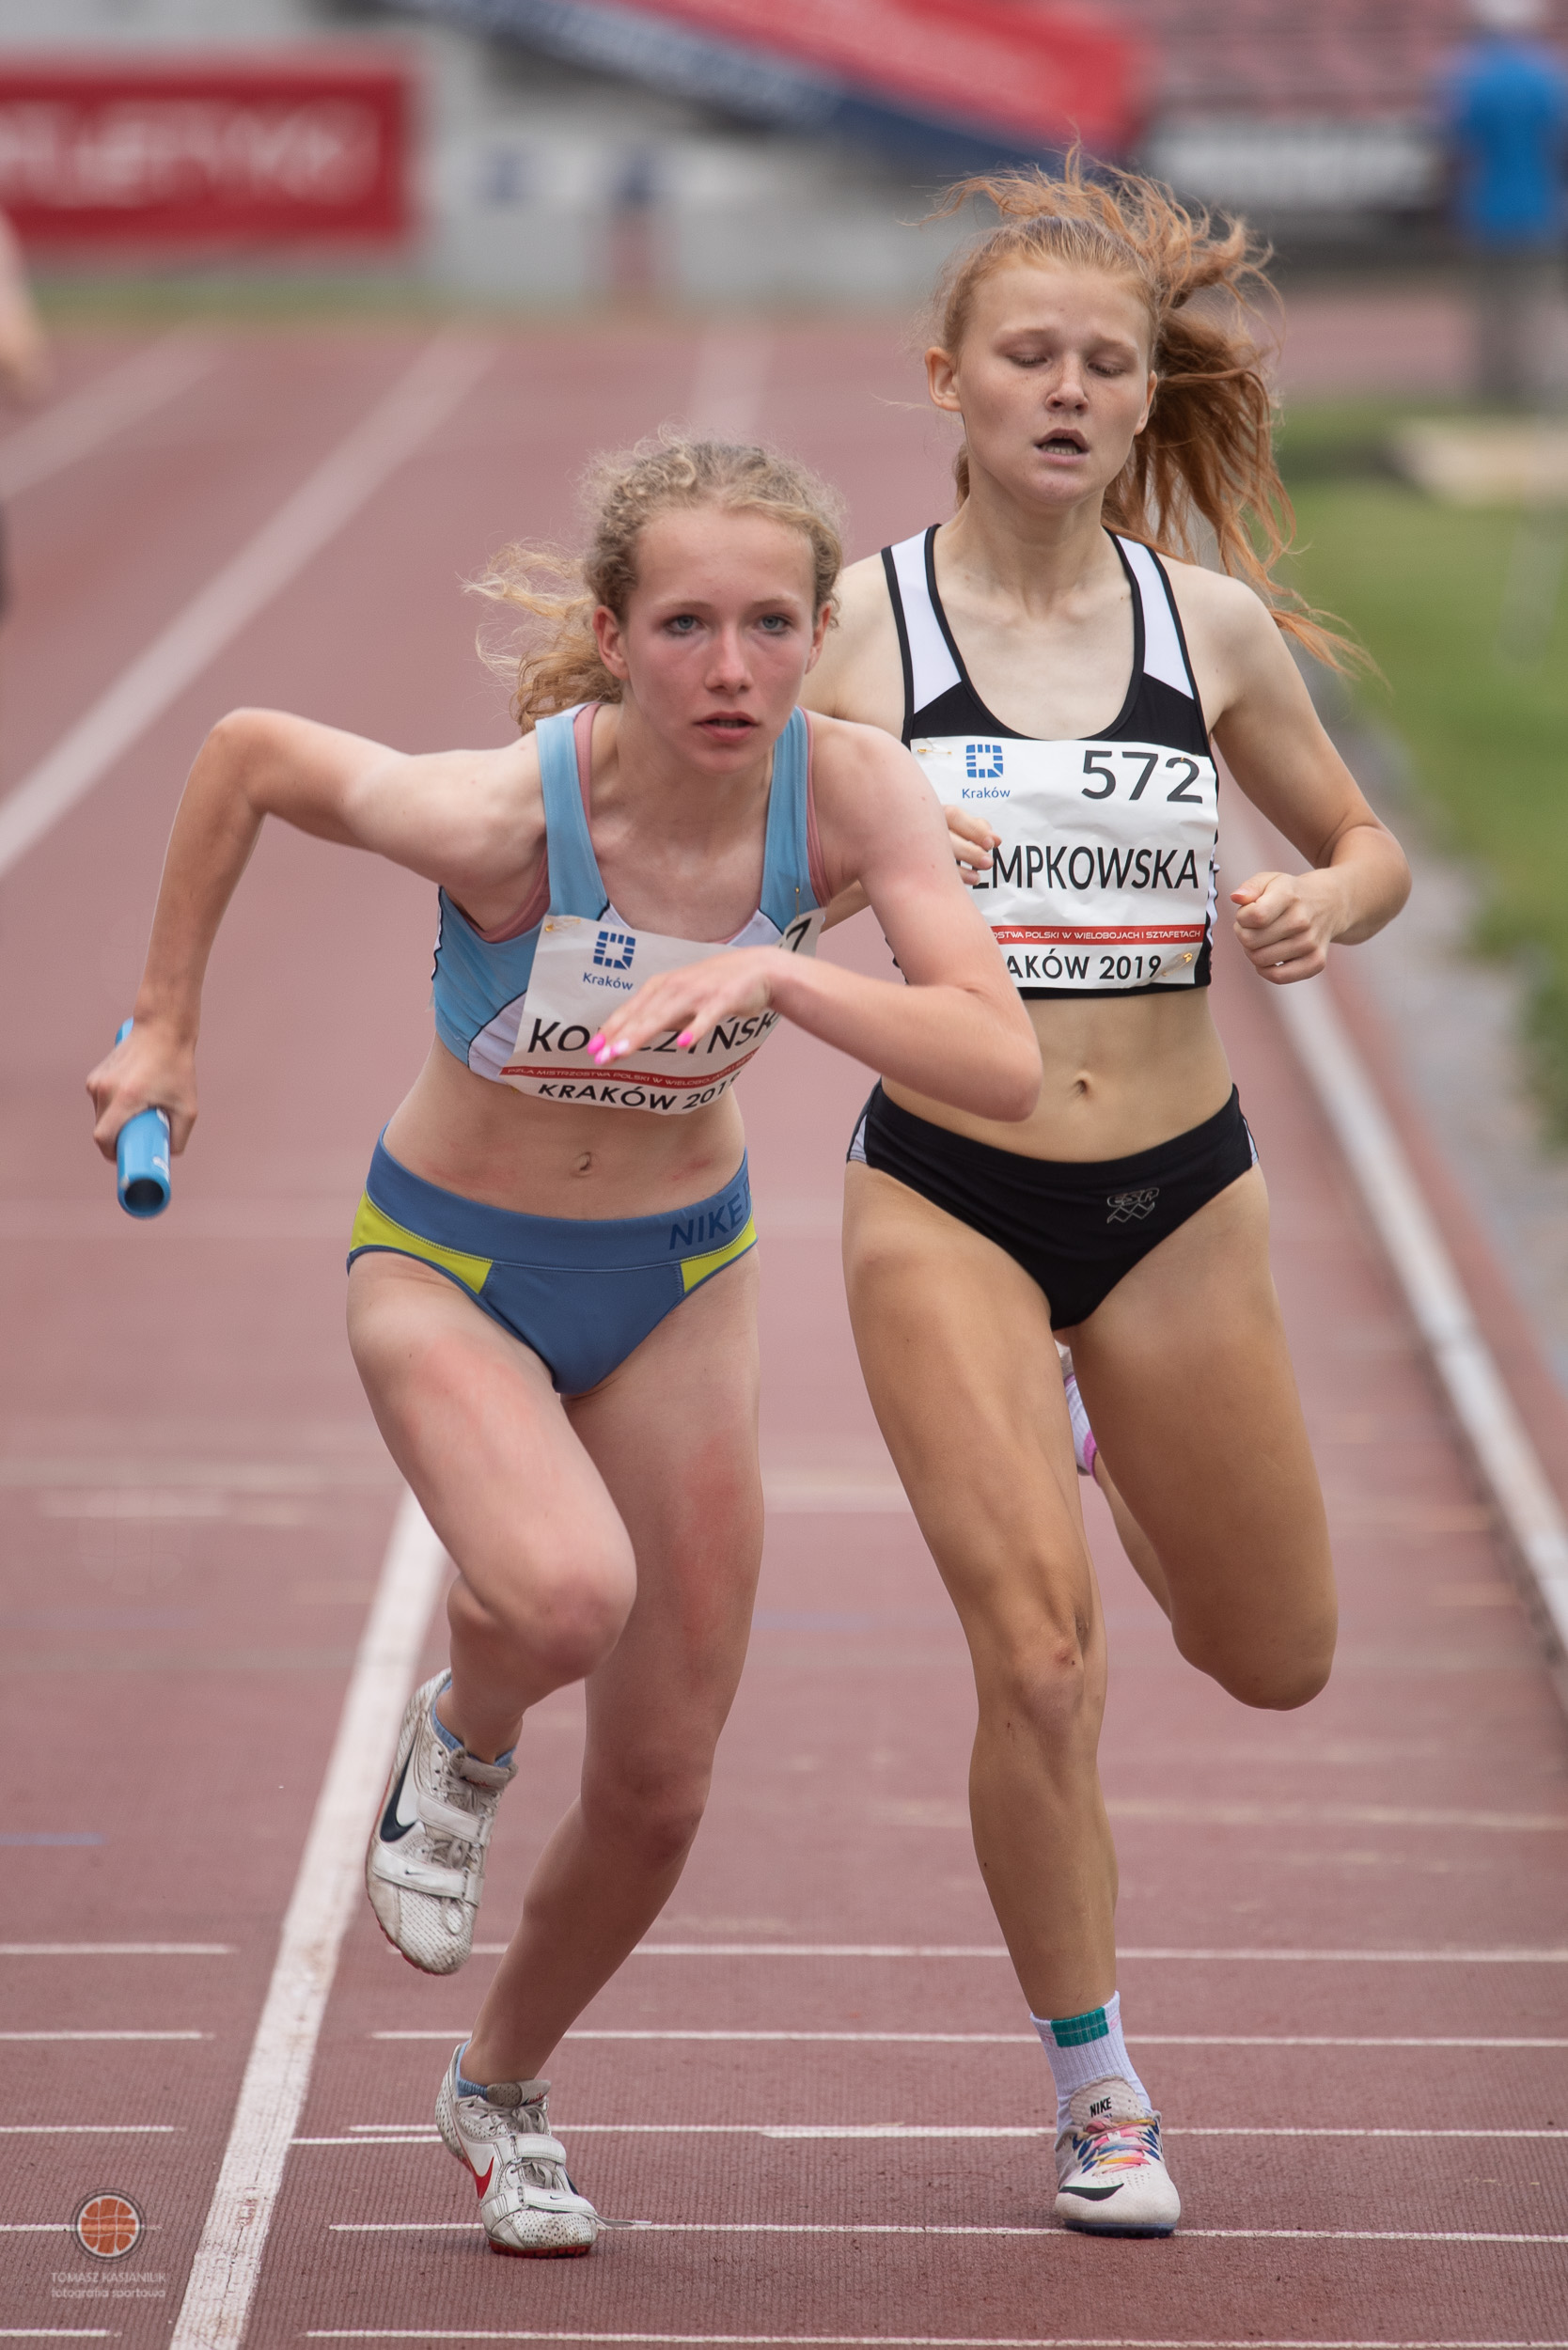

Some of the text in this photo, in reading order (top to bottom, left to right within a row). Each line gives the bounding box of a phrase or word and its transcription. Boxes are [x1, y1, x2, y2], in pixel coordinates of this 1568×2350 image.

[1082, 749, 1203, 804] 572
[962, 787, 1011, 799] Kraków
[956, 845, 1200, 889] MPKOWSKA
[779, 916, 812, 953] 7
[1074, 932, 1139, 940] WIELOBOJACH
[1145, 930, 1201, 939] SZTAFETACH
[1099, 955, 1162, 979] 2019
[582, 971, 635, 991] Kraków
[612, 1072, 651, 1082] POLSKI
[538, 1084, 678, 1110] KRAKÓW
[668, 1192, 745, 1251] NIKE
[1090, 2096, 1112, 2119] NIKE
